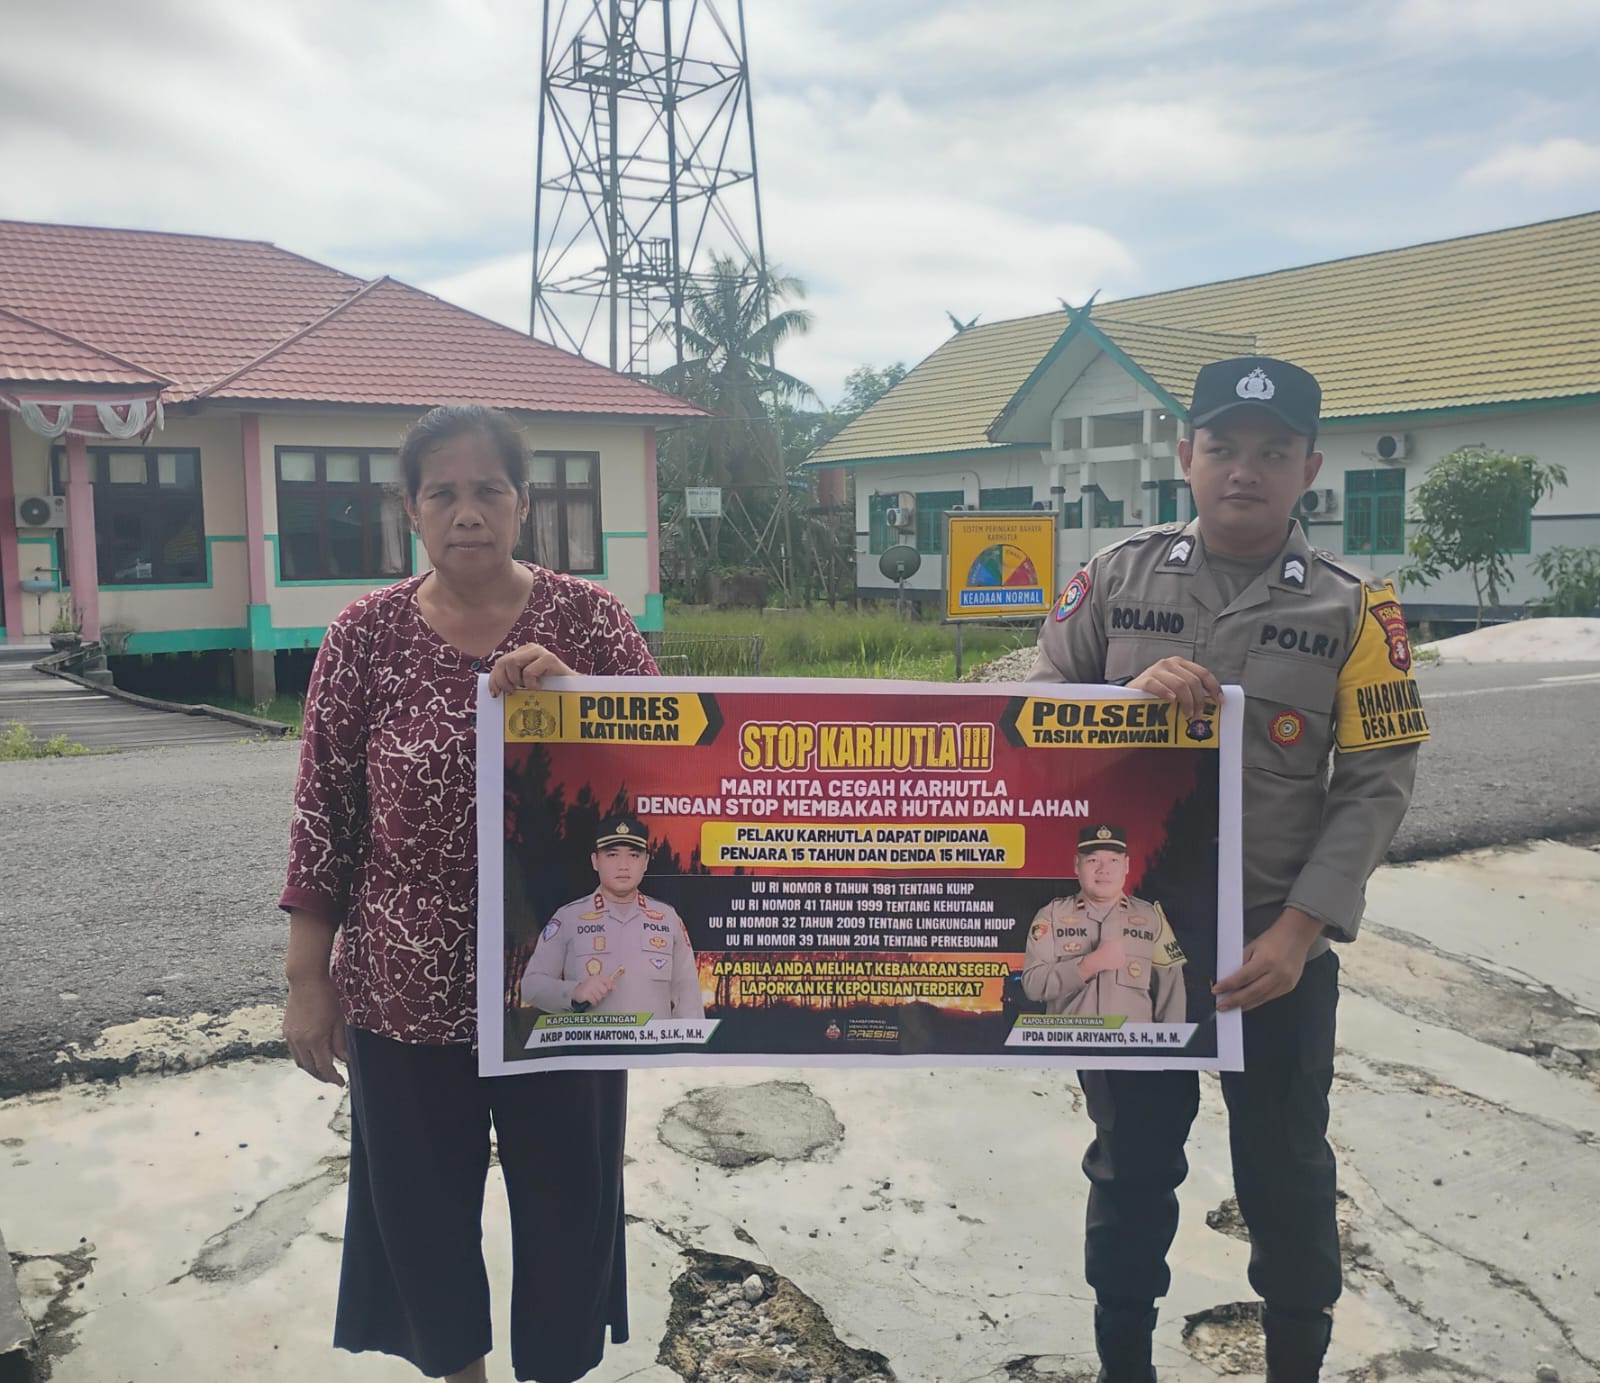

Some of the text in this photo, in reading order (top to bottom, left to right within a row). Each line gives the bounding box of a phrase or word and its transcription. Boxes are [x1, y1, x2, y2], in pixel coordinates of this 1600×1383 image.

[963, 592, 1039, 604] KEADAAN NORMAL
[1112, 608, 1184, 634] ROLAND
[1260, 624, 1337, 658] POLRI
[579, 696, 679, 720] POLRES
[1032, 702, 1170, 727] POLSEK
[580, 722, 679, 741] KATINGAN
[1362, 715, 1396, 740] DESA
[1033, 729, 1169, 744] TASIK PAYAWAN
[743, 725, 990, 768] STOP KARHUTLA !!!
[721, 779, 1007, 797] MARI KITA CEGAH KARHUTLA
[637, 797, 1089, 817] DENGAN STOP MEMBAKAR HUTAN DAN LAHAN
[738, 828, 988, 843] PELAKU KARHUTLA DAPAT DIPIDANA
[721, 847, 1005, 862] PENJARA 15 TAHUN DAN DENDA 15 MILYAR
[752, 882, 974, 895] UU RI NOMOR 8 TAHUN 1981 TENTANG KUHP
[732, 899, 994, 912] UU RI NOMOR 41 TAHUN 1999 TENTANG KEHUTANAN
[577, 924, 606, 934] DODIK
[643, 922, 670, 933] POLRI
[709, 917, 1015, 930] UU RI NOMOR 32 TAHUN 2009 TENTANG LINGKUNGAN HIDUP
[1056, 927, 1087, 938] DIDIK
[1122, 928, 1153, 941] POLRI
[726, 934, 998, 948] UU RI NOMOR 39 TAHUN 2014 TENTANG PERKEBUNAN
[714, 962, 1009, 976] APABILA ANDA MELIHAT KEBAKARAN SEGERA
[741, 982, 982, 995] LAPORKAN KE KEPOLISIAN TERDEKAT
[546, 1015, 637, 1025] KAPOLRES KATINGAN
[540, 1031, 563, 1043] AKBP
[565, 1030, 591, 1041] DODIK
[594, 1030, 637, 1043] HARTONO,
[639, 1030, 658, 1041] S.H.,
[686, 1029, 704, 1039] M.H.
[847, 1030, 899, 1038] PRESISI
[1022, 1032, 1044, 1042] IPDA
[1047, 1032, 1073, 1042] DIDIK
[1076, 1032, 1126, 1045] ARIYANTO,
